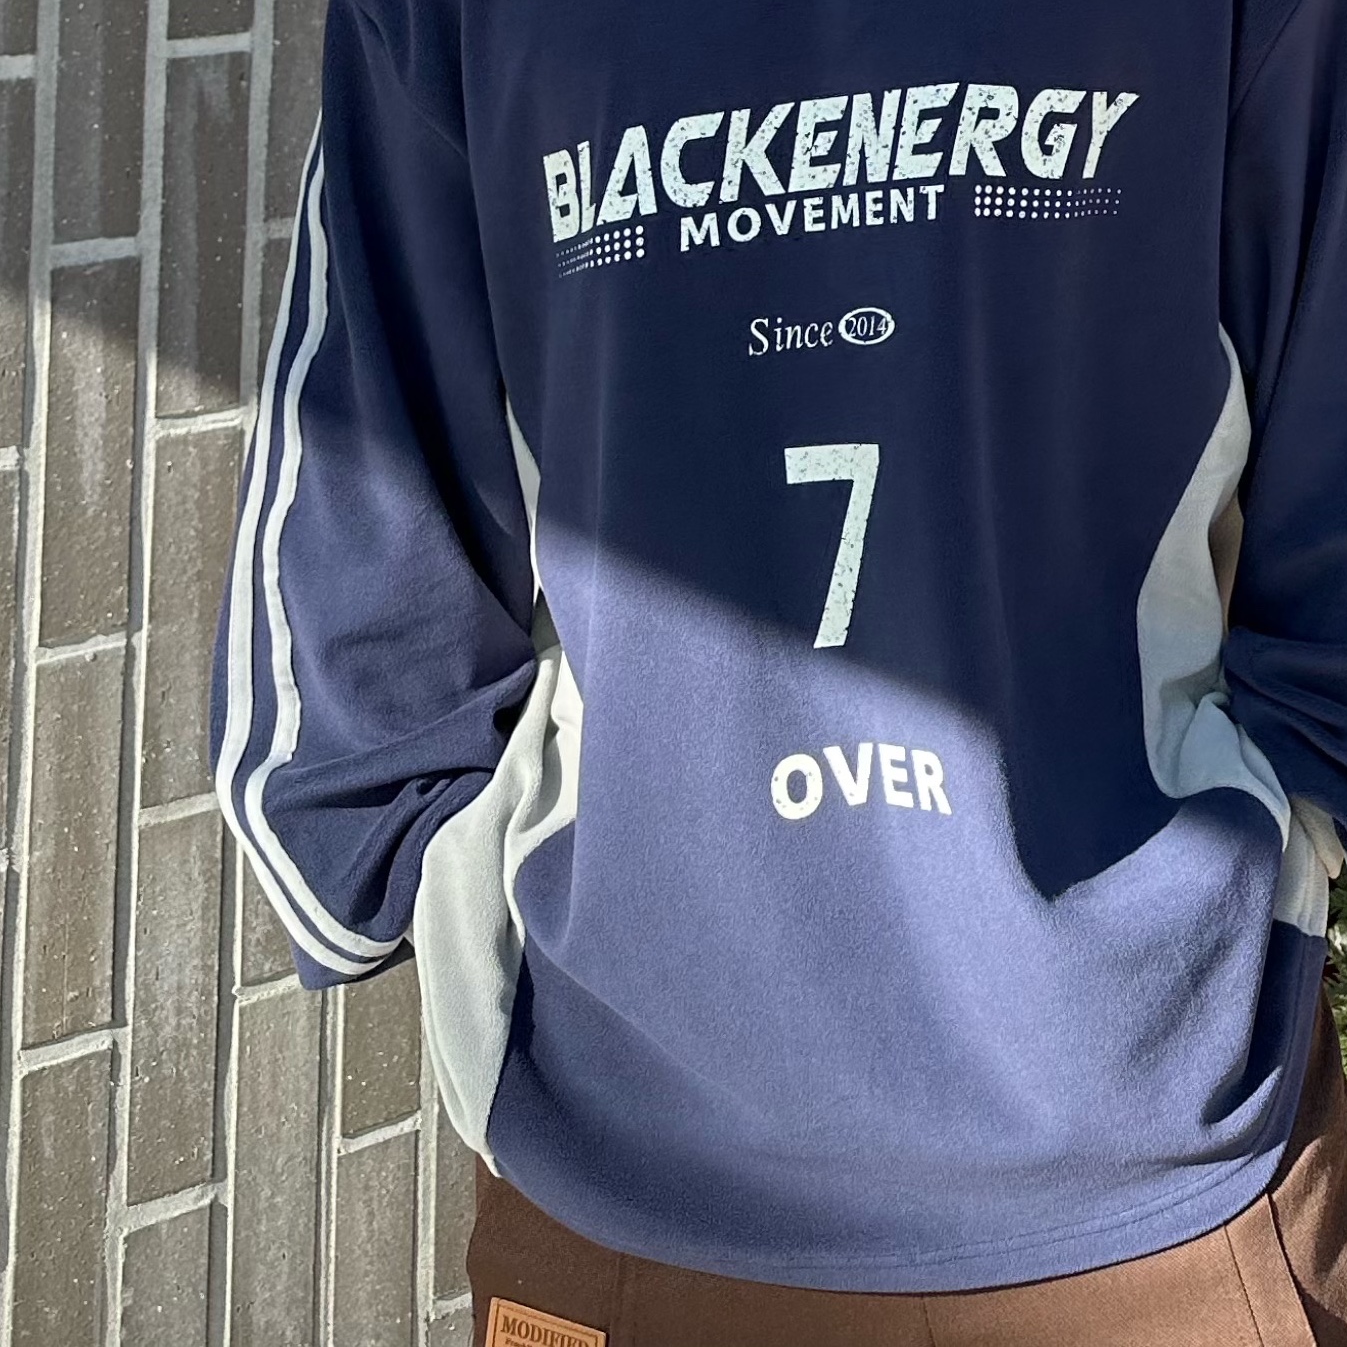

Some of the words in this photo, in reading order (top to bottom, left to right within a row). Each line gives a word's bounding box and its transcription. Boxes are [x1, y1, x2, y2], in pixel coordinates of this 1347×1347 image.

[543, 83, 1140, 243] BLACKENERGY
[681, 184, 945, 252] MOVEMENT
[748, 317, 833, 356] Since
[849, 315, 887, 338] 2014
[784, 443, 880, 649] 7
[771, 742, 952, 820] OVER
